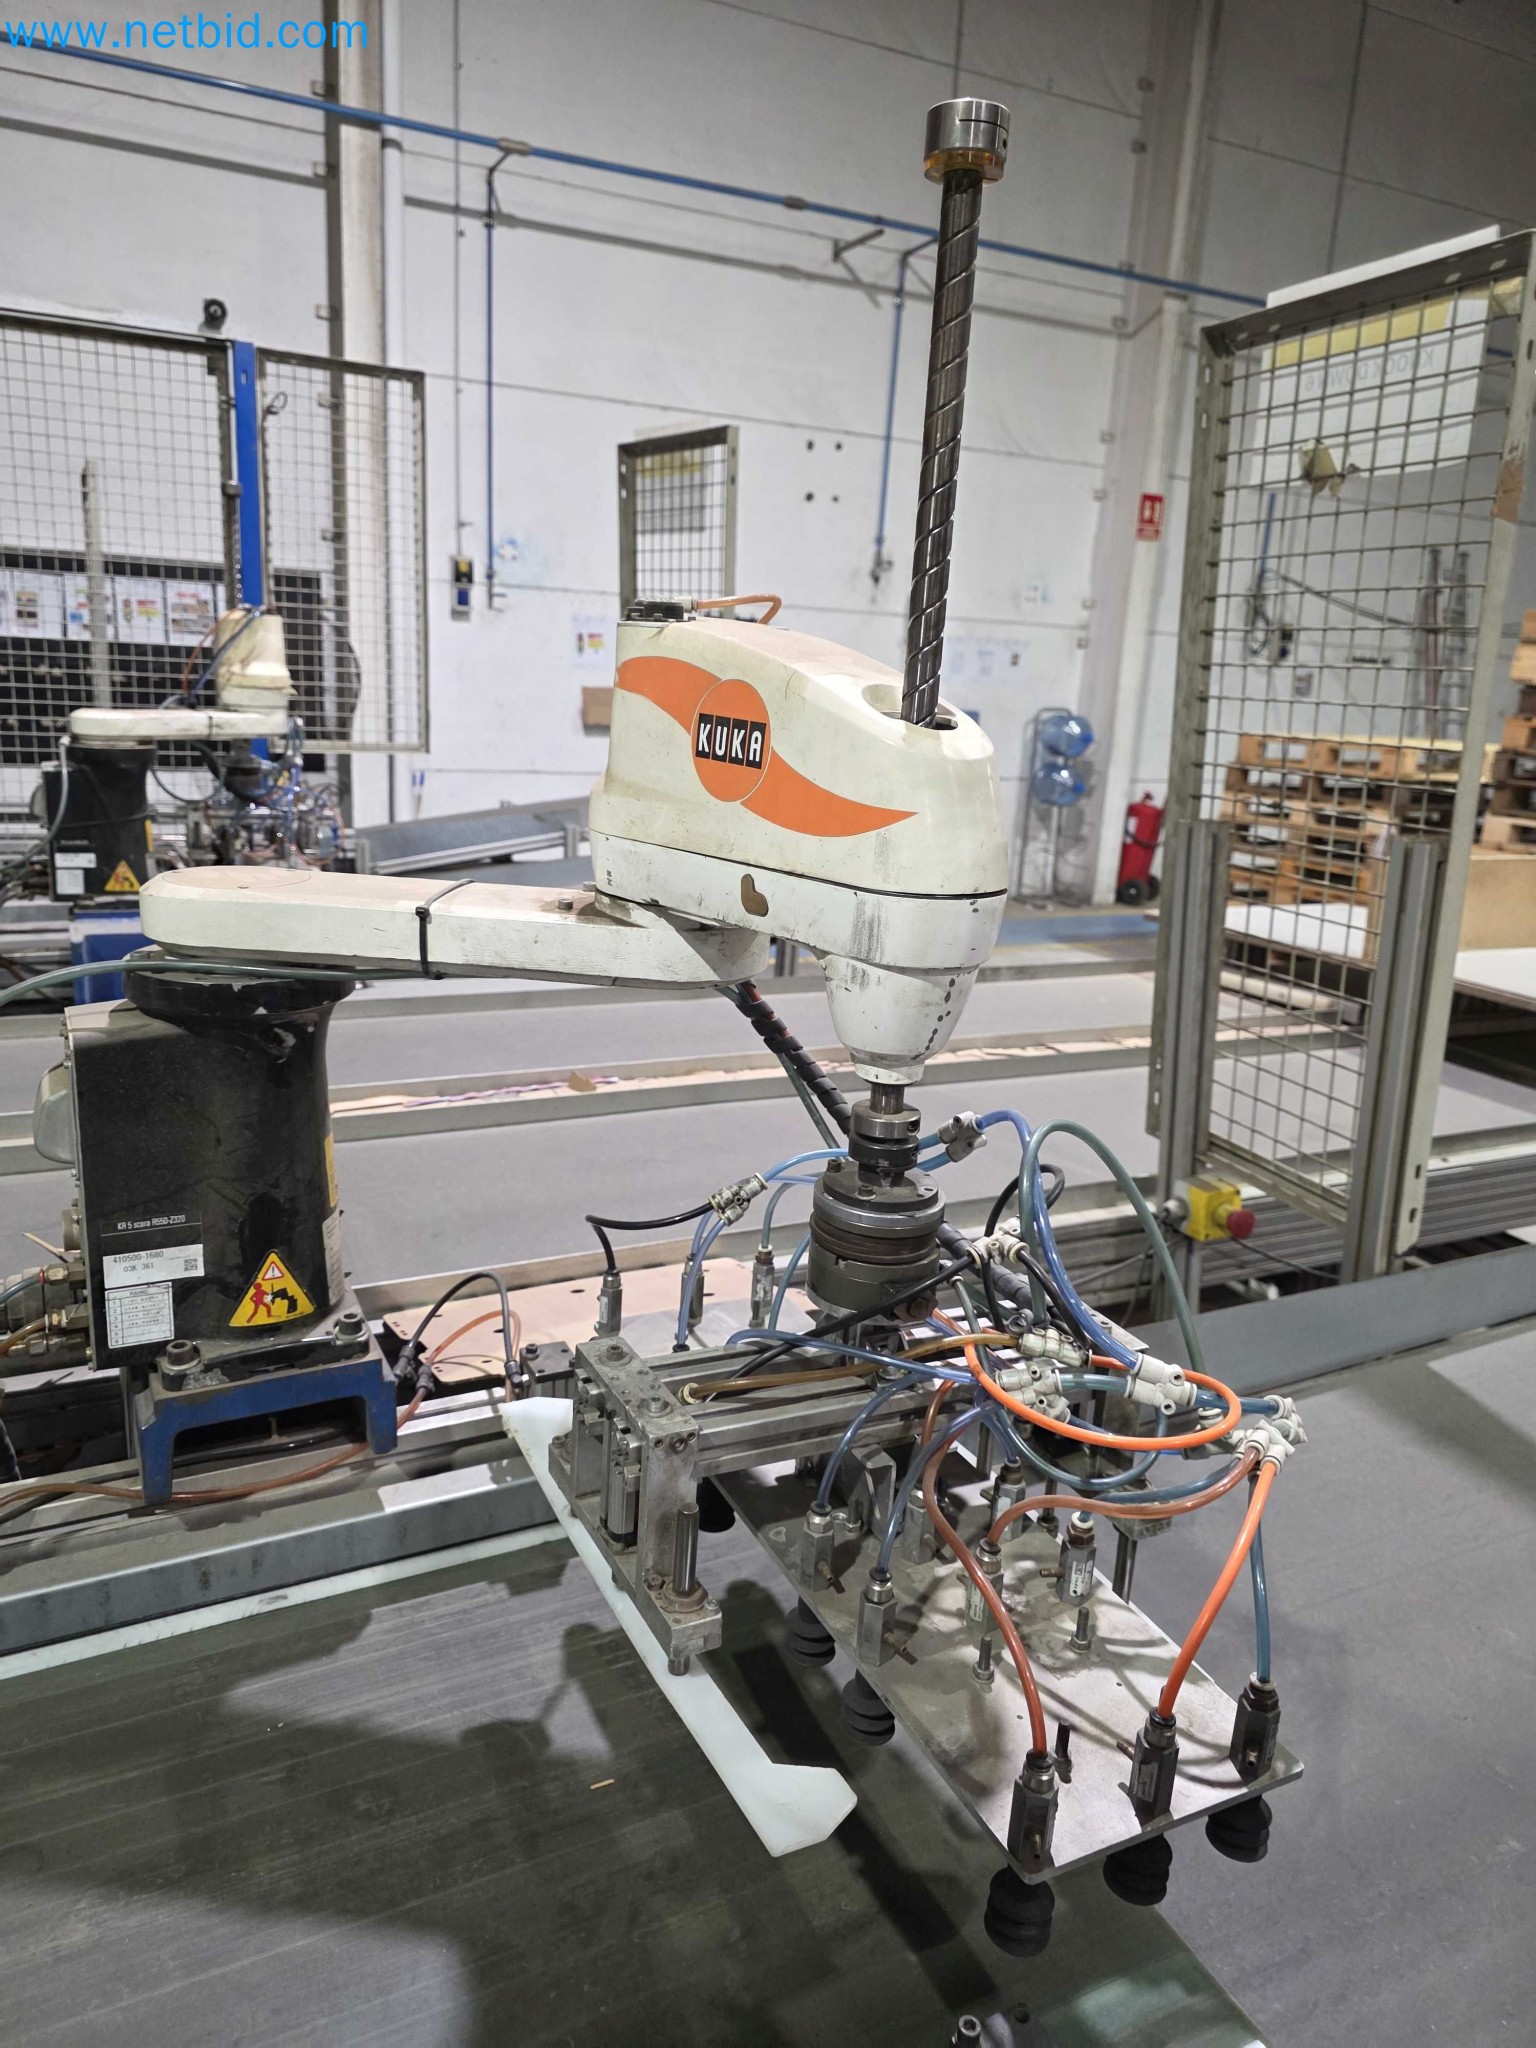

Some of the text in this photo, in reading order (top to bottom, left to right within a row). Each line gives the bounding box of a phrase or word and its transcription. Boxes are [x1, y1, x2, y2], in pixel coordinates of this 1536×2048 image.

[698, 722, 763, 762] KUKA
[118, 1222, 127, 1230] KR
[127, 1222, 133, 1230] 5
[112, 1250, 164, 1263] 410500-1680
